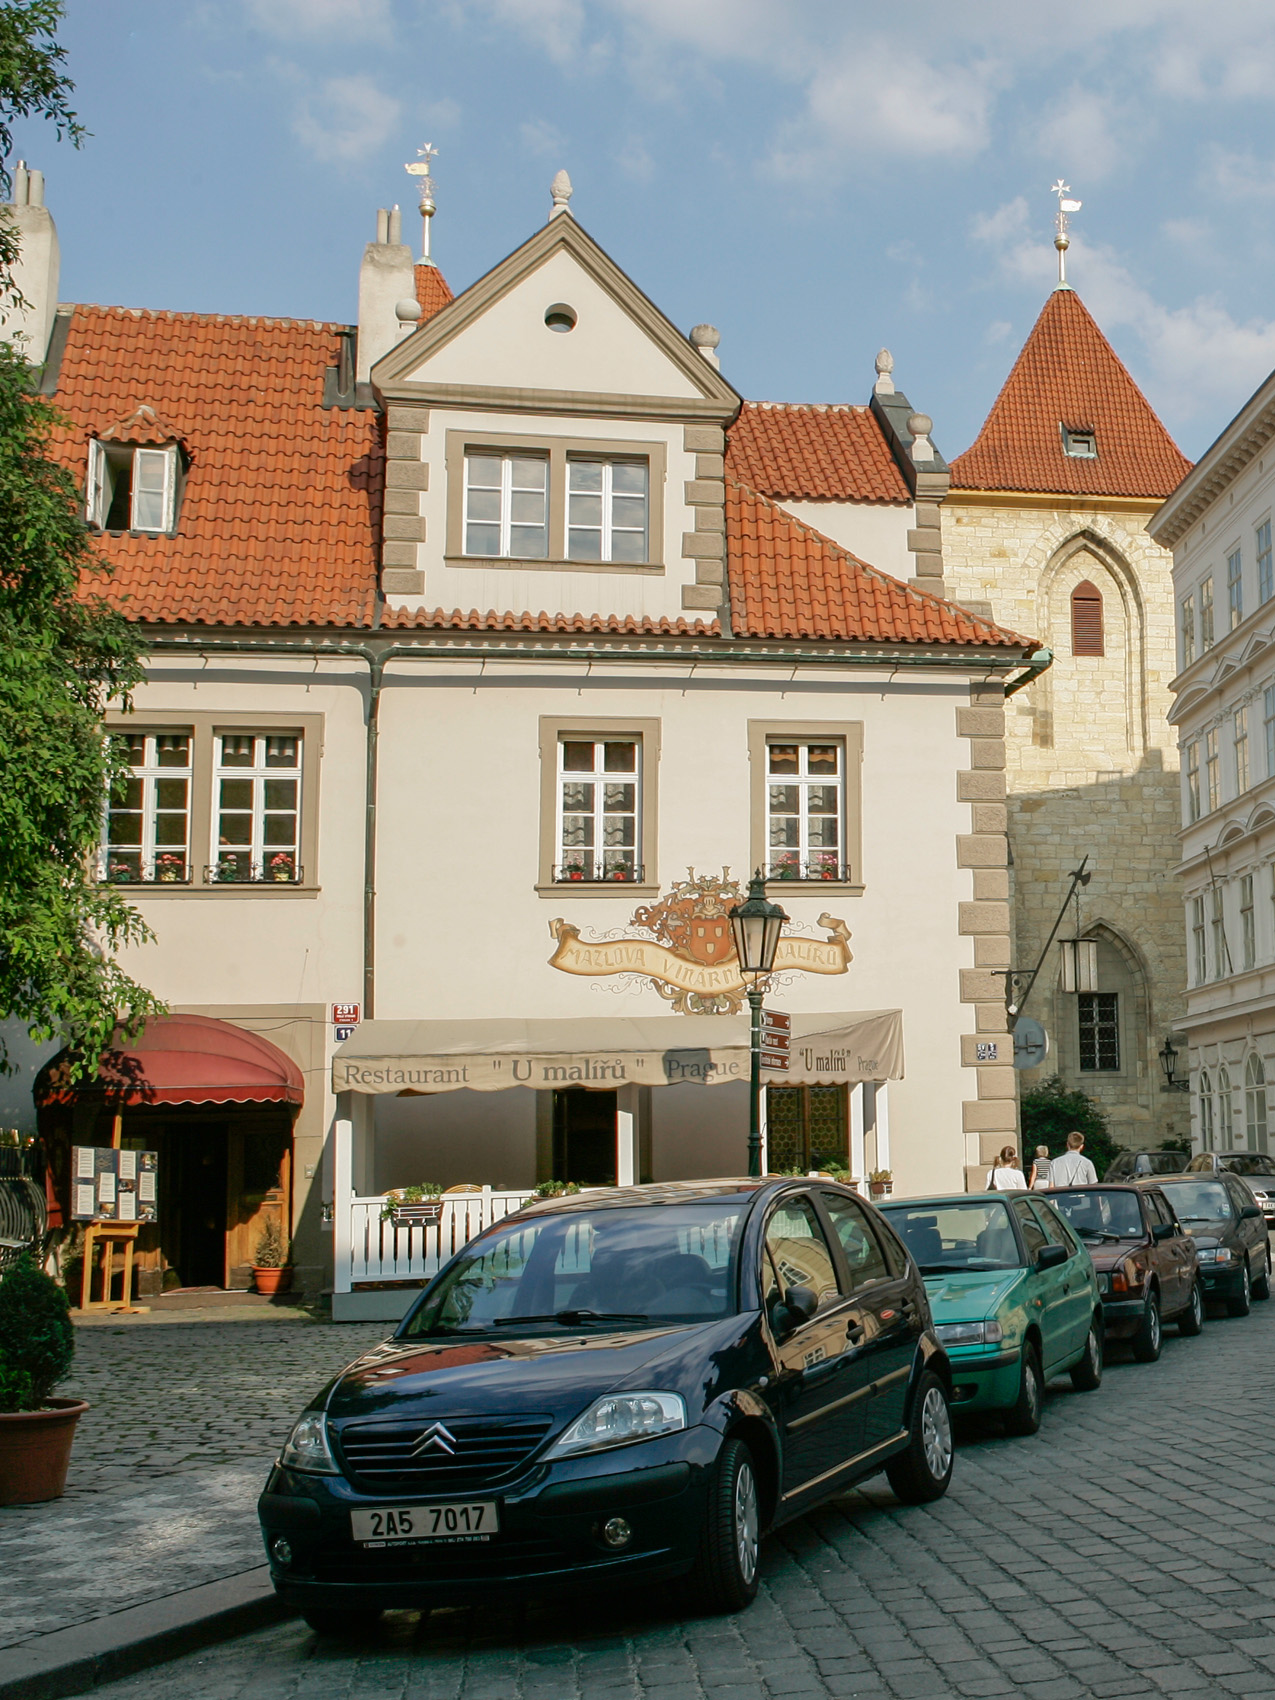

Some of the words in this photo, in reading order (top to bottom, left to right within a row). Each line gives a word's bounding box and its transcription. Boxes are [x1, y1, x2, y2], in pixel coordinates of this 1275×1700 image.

[561, 946, 646, 968] MAZLOVA
[336, 1005, 354, 1015] 291
[344, 1064, 470, 1085] Restaurant
[542, 1058, 626, 1081] malířů
[667, 1058, 740, 1082] Prague
[858, 1055, 879, 1076] Prague
[370, 1510, 413, 1536] 2A5
[429, 1505, 485, 1533] 7017
